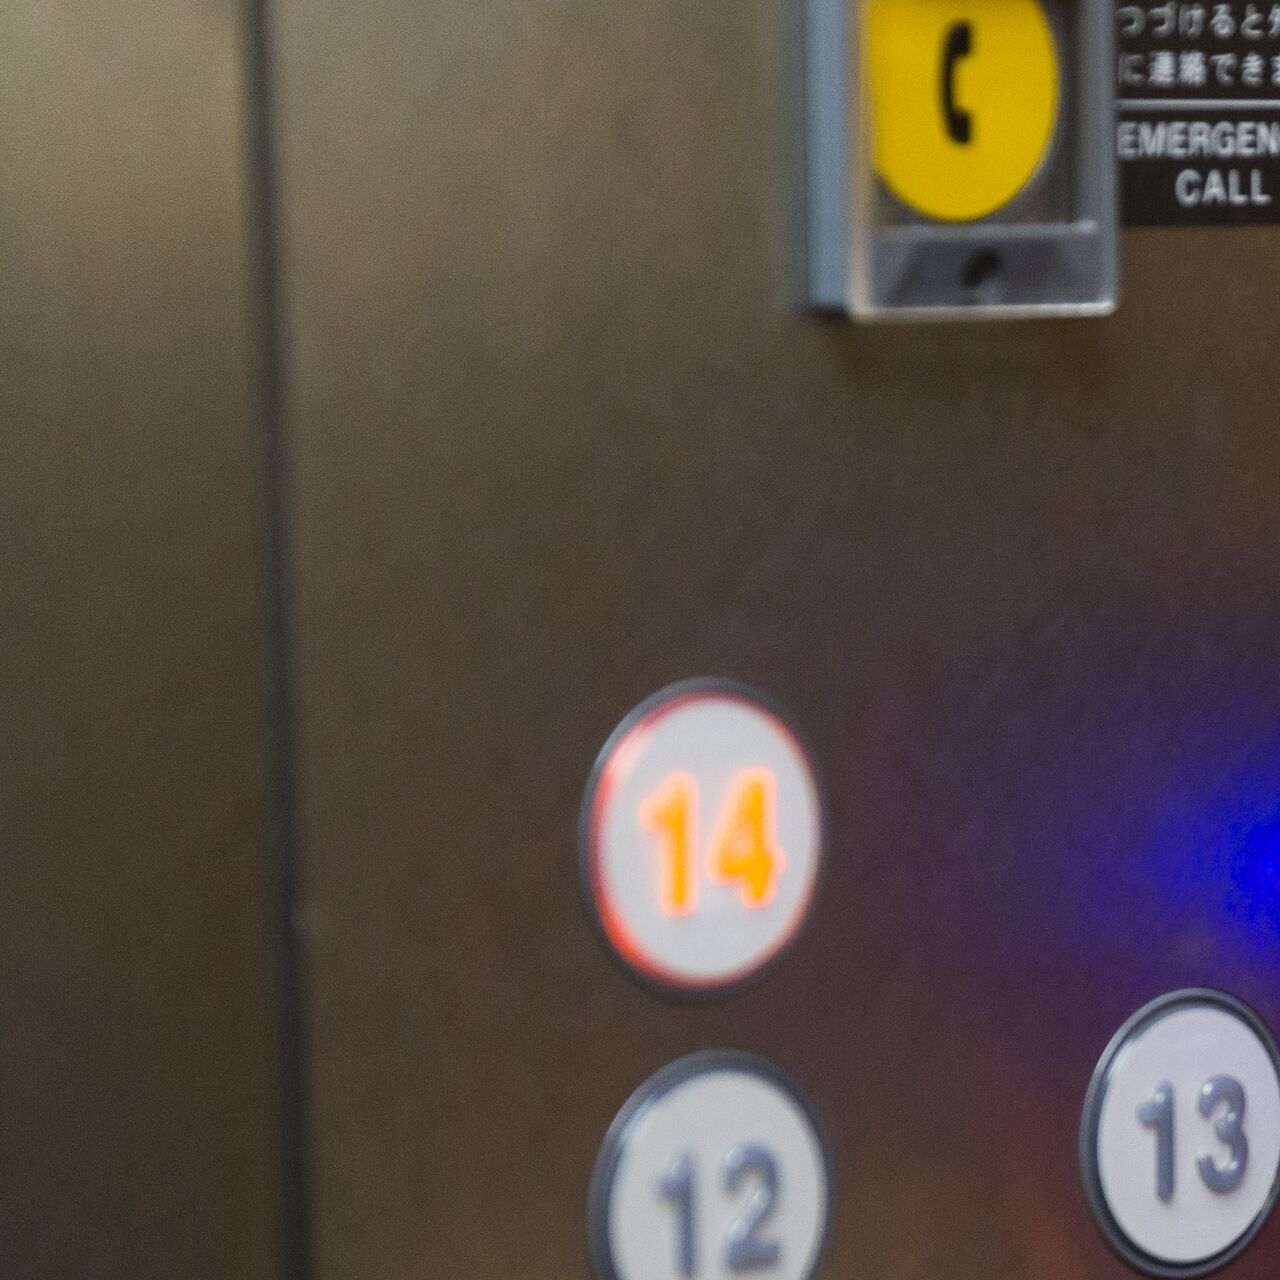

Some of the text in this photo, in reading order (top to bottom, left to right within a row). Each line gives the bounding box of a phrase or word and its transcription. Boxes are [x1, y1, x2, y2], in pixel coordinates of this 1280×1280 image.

[1174, 167, 1273, 208] CALL
[639, 767, 786, 917] 14
[1137, 1074, 1250, 1203] 13
